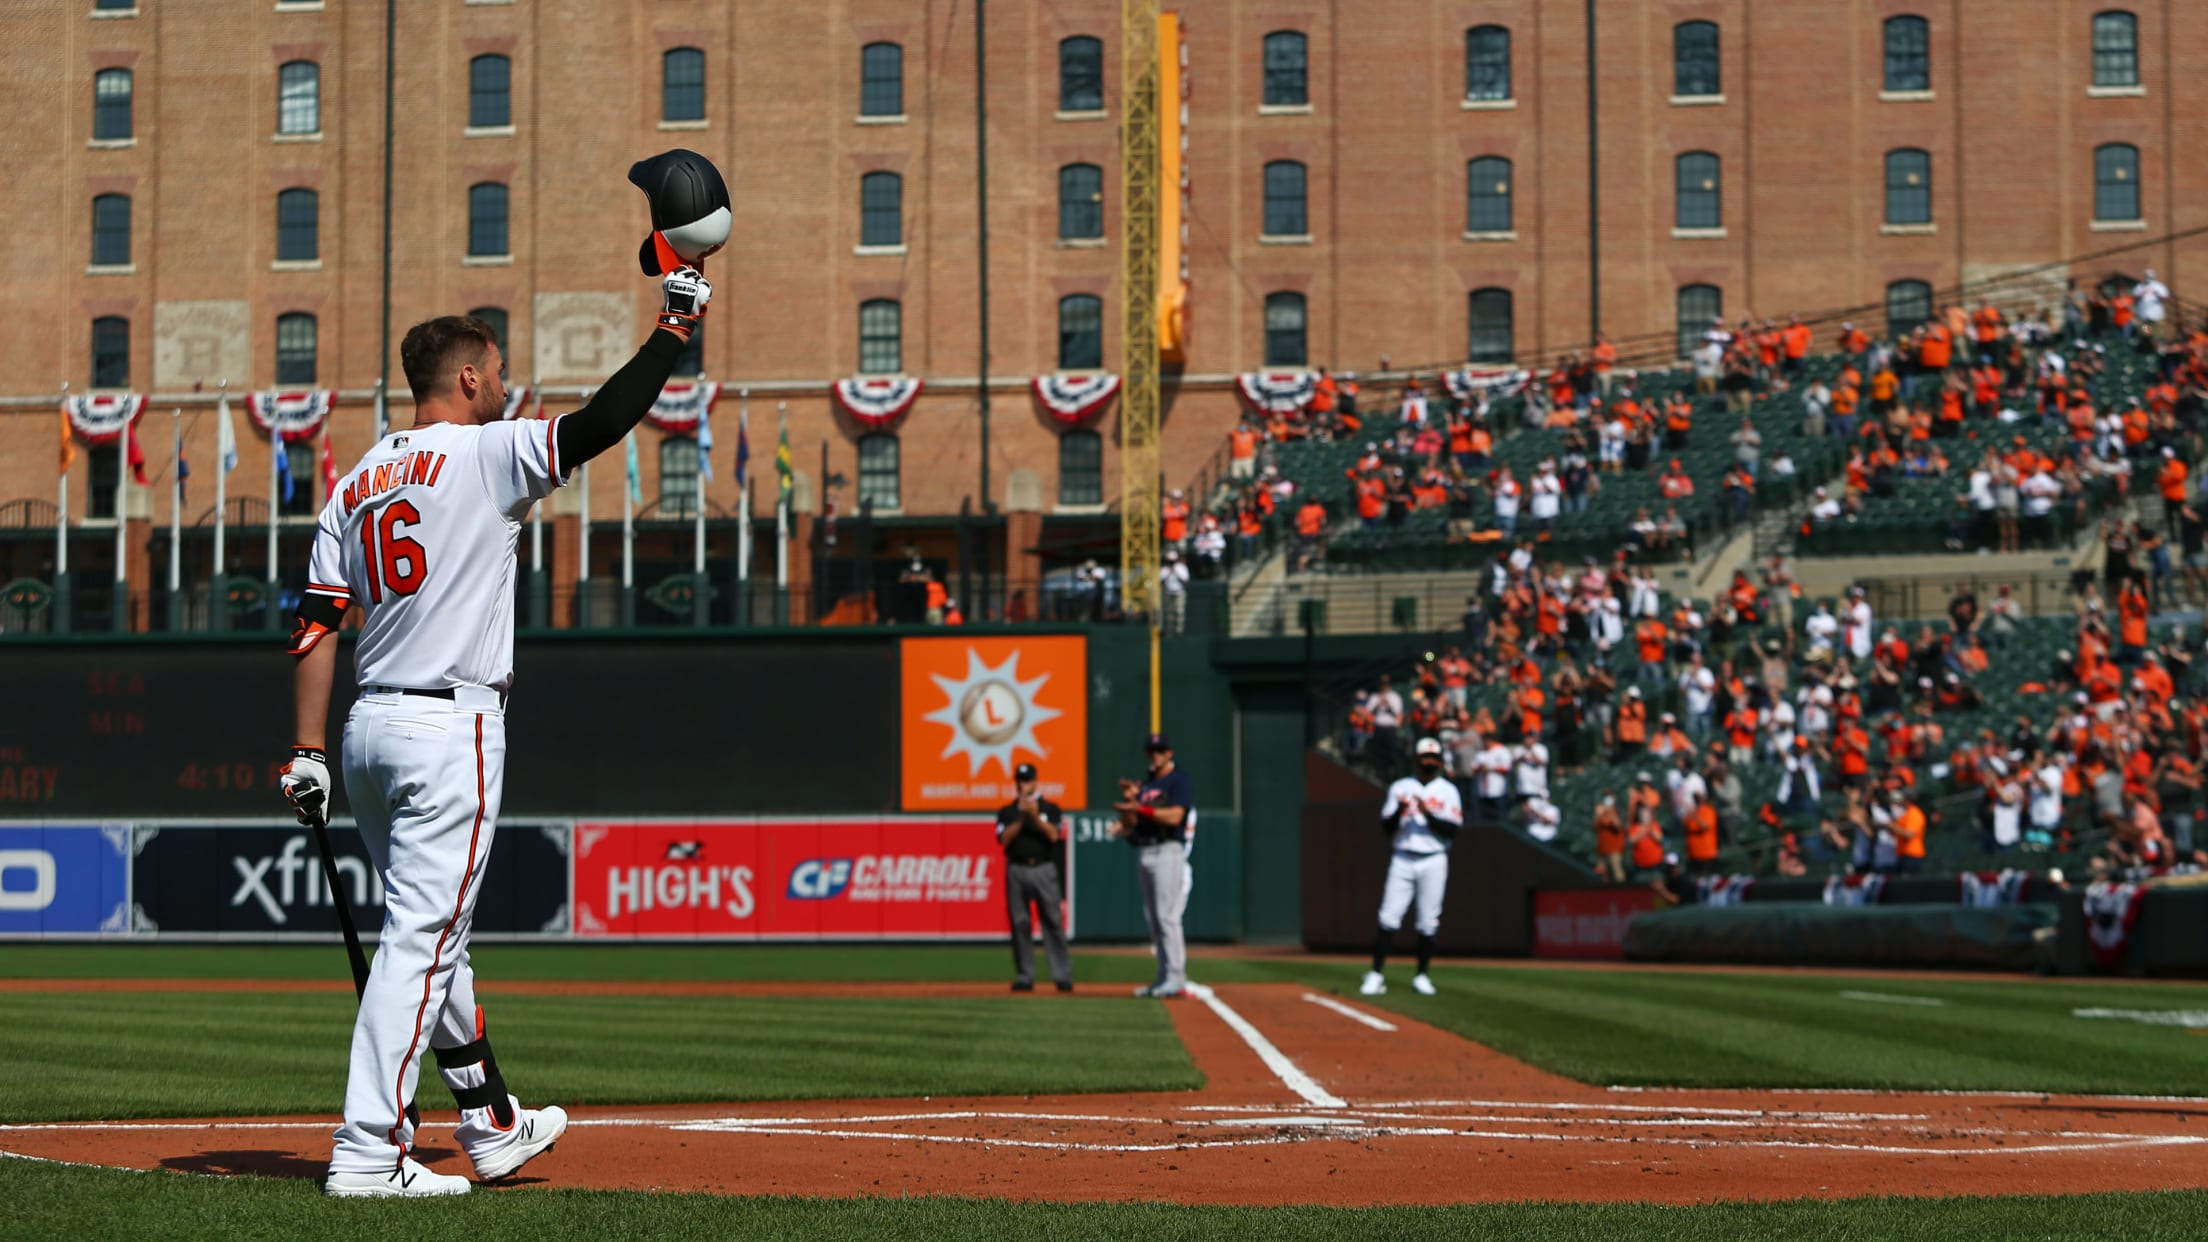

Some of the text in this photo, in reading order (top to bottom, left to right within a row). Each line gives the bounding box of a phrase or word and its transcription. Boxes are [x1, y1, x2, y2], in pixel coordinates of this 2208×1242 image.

[343, 451, 446, 517] MANCINI
[361, 499, 428, 605] 16
[985, 698, 1004, 725] L
[177, 762, 253, 788] 4:10
[607, 864, 755, 919] HIGH'S
[853, 855, 990, 886] CARROLL
